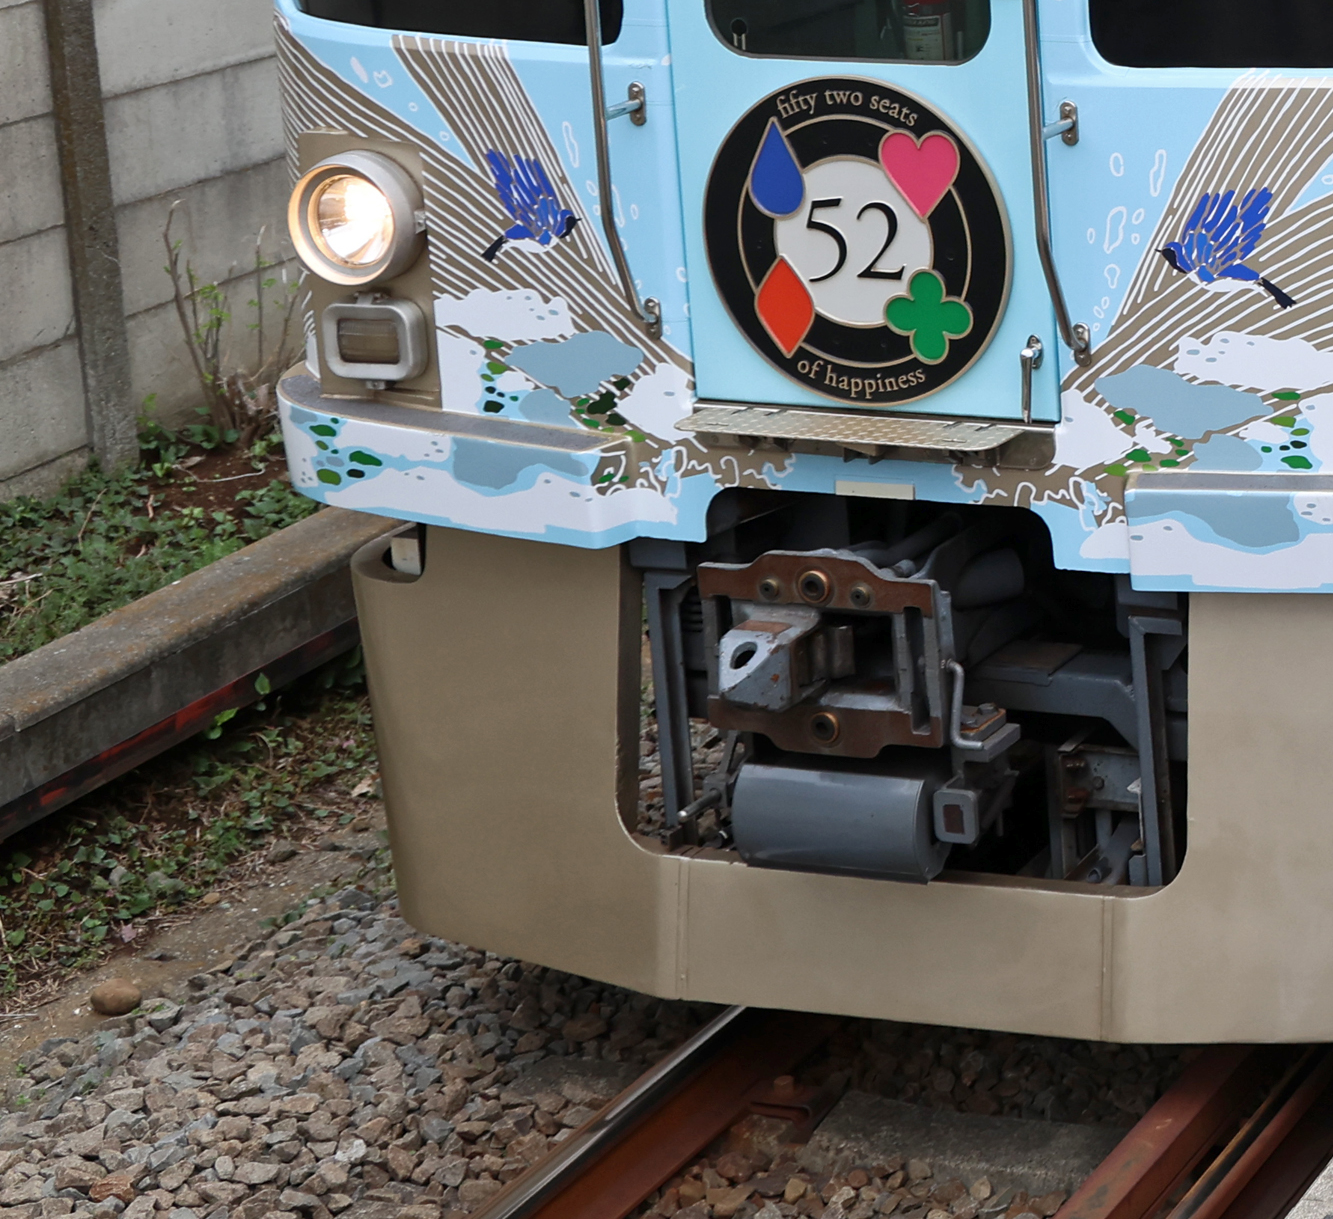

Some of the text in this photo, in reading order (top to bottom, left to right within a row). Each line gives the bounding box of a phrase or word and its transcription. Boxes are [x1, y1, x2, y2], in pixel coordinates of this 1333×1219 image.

[776, 89, 919, 127] fifty two seats
[806, 196, 907, 283] 52
[797, 360, 926, 400] of happiness
